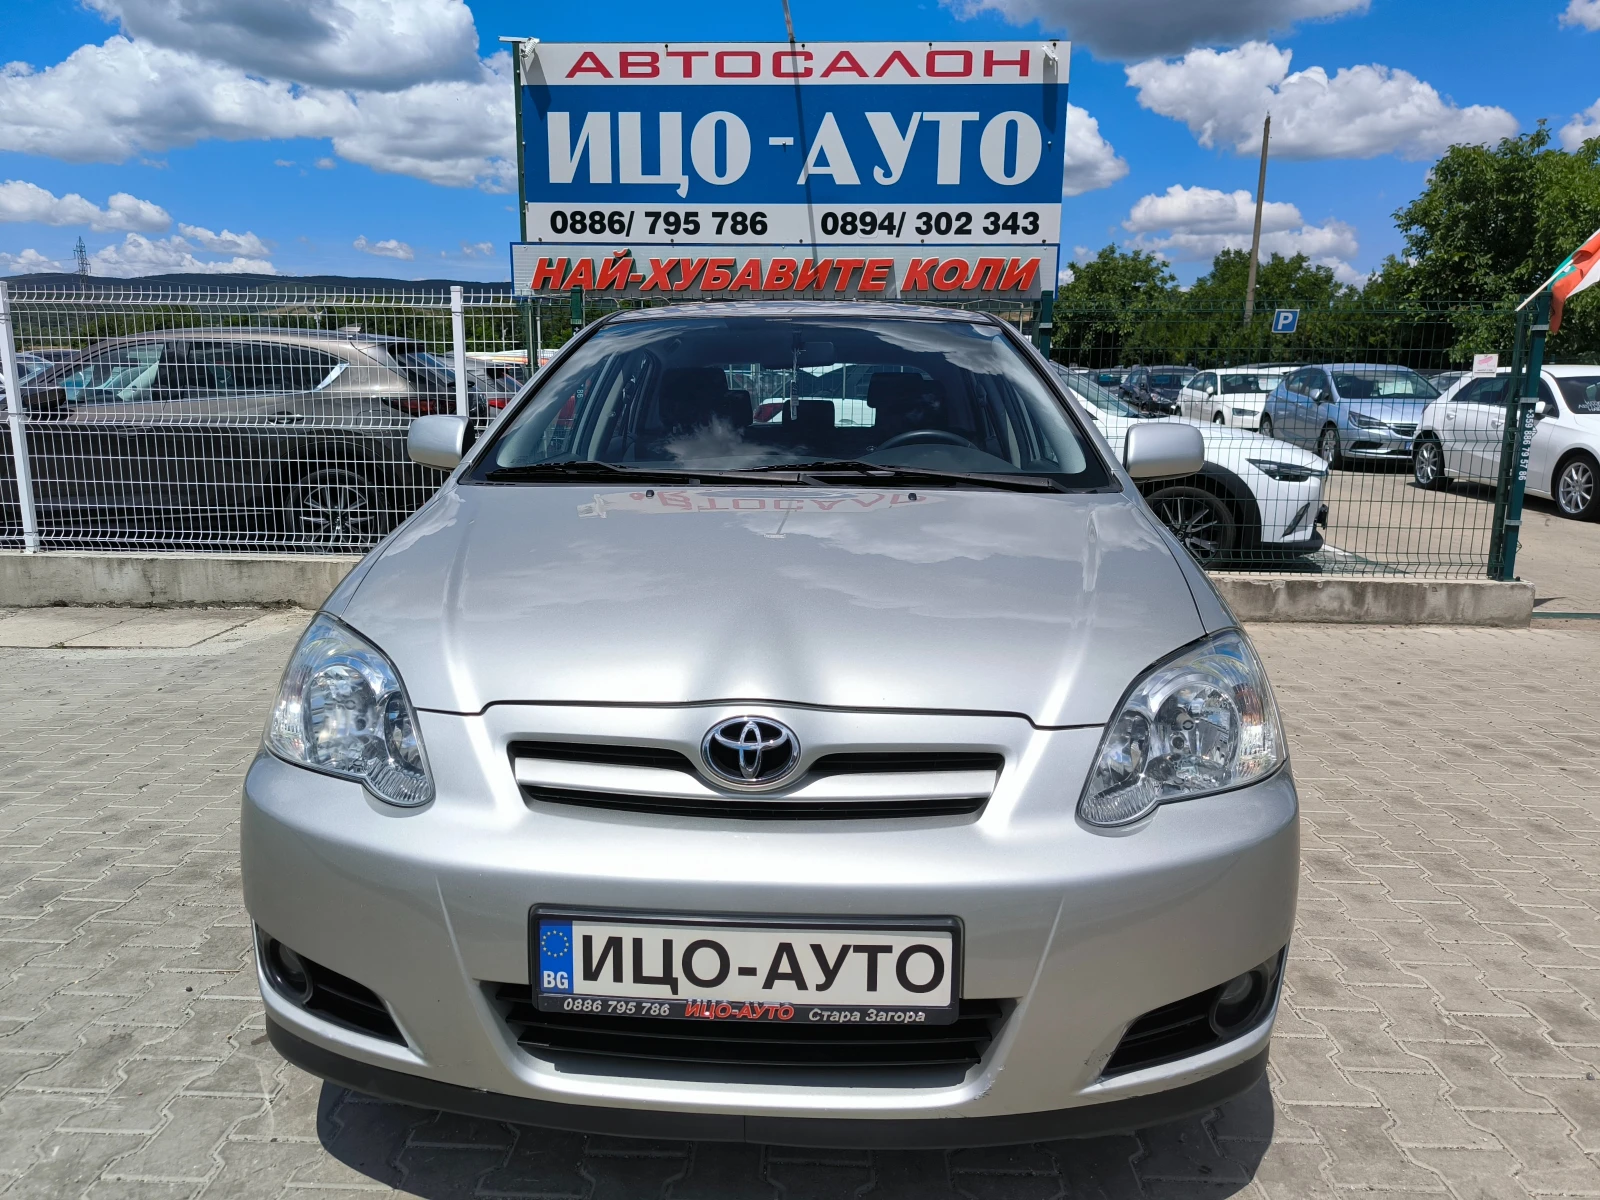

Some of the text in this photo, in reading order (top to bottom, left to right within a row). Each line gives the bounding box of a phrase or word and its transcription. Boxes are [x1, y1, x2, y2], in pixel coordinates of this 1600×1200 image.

[564, 49, 1030, 79] АВТОСАЛОН
[549, 210, 1040, 238] 0886/ 795 786 0894/ 302 343
[530, 248, 1042, 292] НАЙ-ХУБАВИТЕ КОЛИ
[1277, 312, 1293, 330] P
[1518, 408, 1535, 480] +359 886 79 57 86
[581, 934, 945, 996] ИЦО-АУТО
[543, 970, 570, 990] BG
[563, 998, 670, 1016] 0886 795 786
[685, 1002, 794, 1020] ИЦО-АУТО
[808, 1008, 926, 1024] Стара Загора
